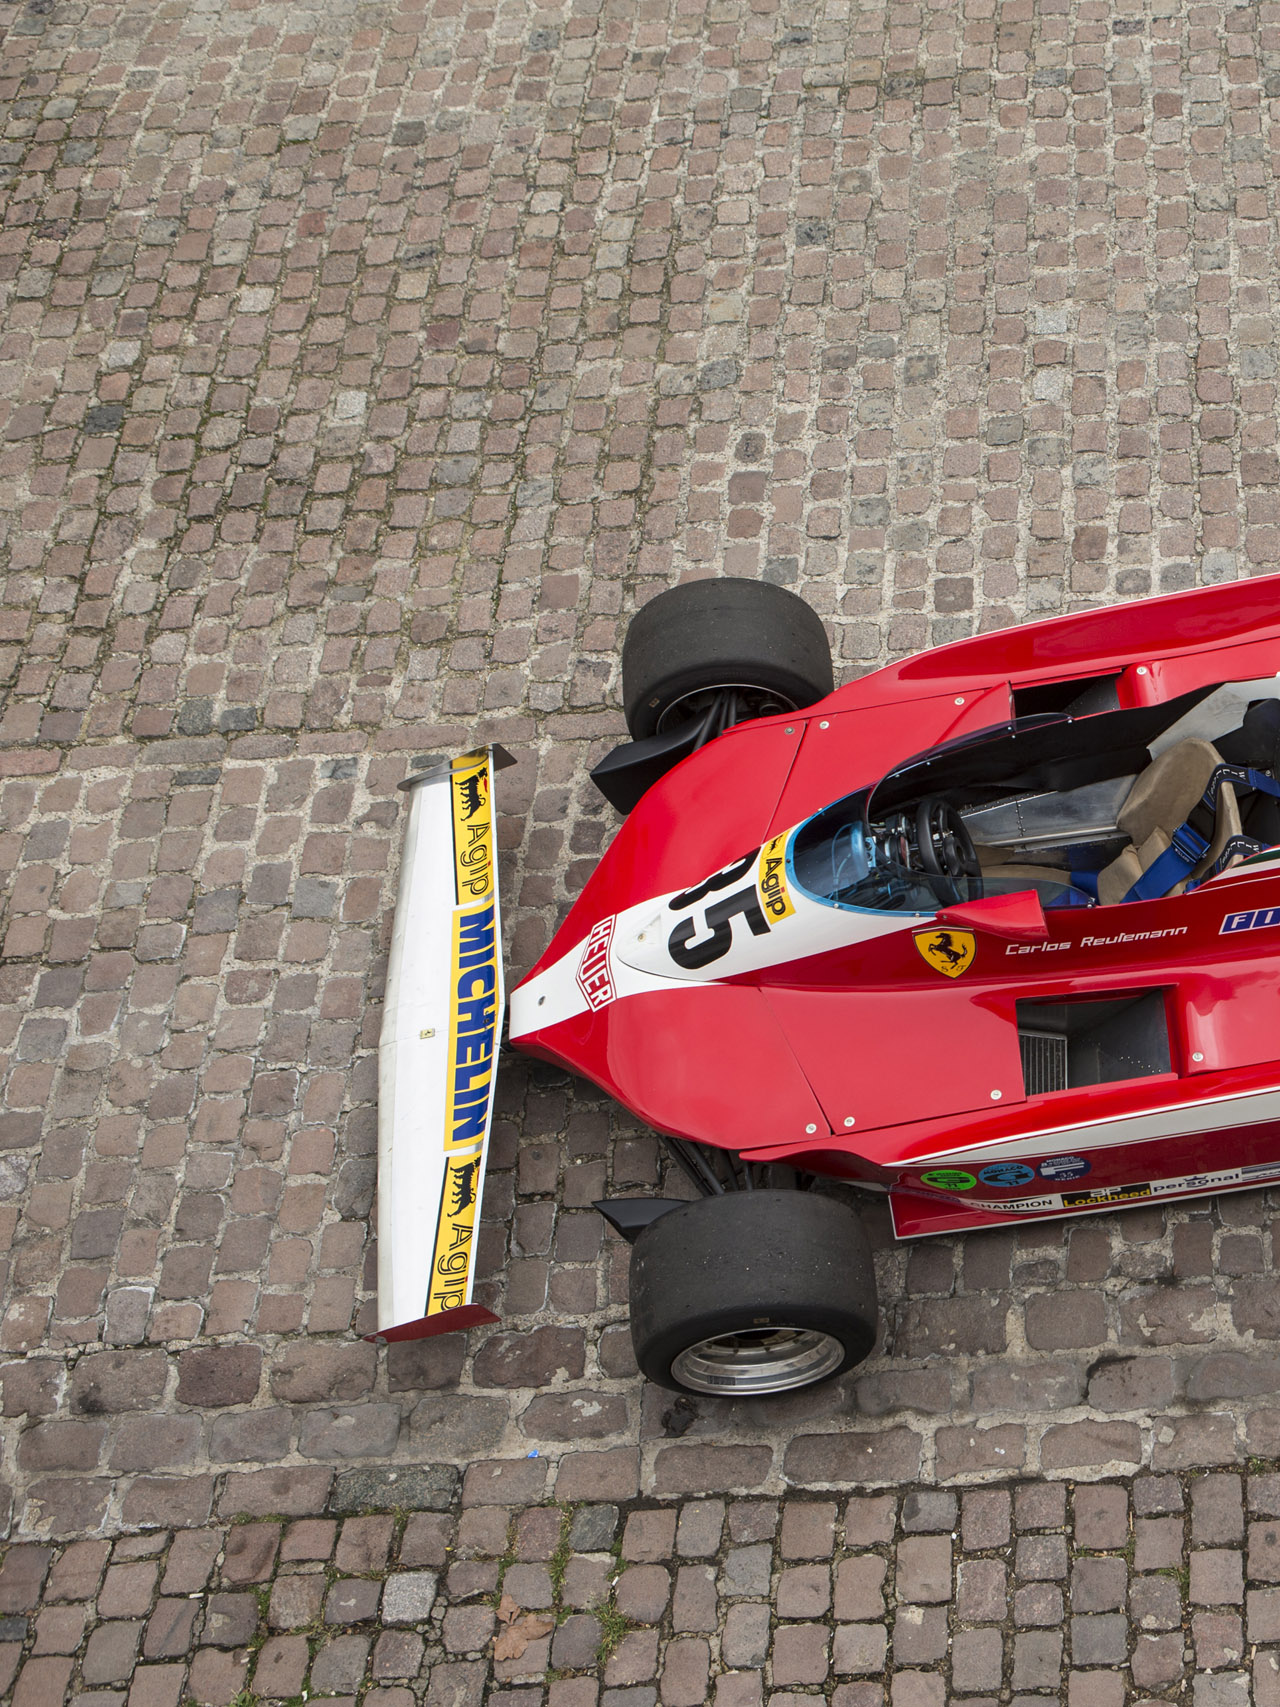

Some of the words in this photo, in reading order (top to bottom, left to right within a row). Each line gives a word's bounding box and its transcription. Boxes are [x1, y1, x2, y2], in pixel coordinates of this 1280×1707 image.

[460, 823, 493, 896] Agip
[761, 857, 787, 916] Agip
[668, 845, 771, 969] 35
[1005, 940, 1071, 955] Carlos
[1080, 926, 1188, 948] Reutemann
[579, 920, 613, 1006] HEUER
[452, 903, 497, 1144] MICHELIN
[1063, 1188, 1151, 1208] Lockheed
[1153, 1173, 1240, 1193] personal
[432, 1222, 474, 1312] Agip
